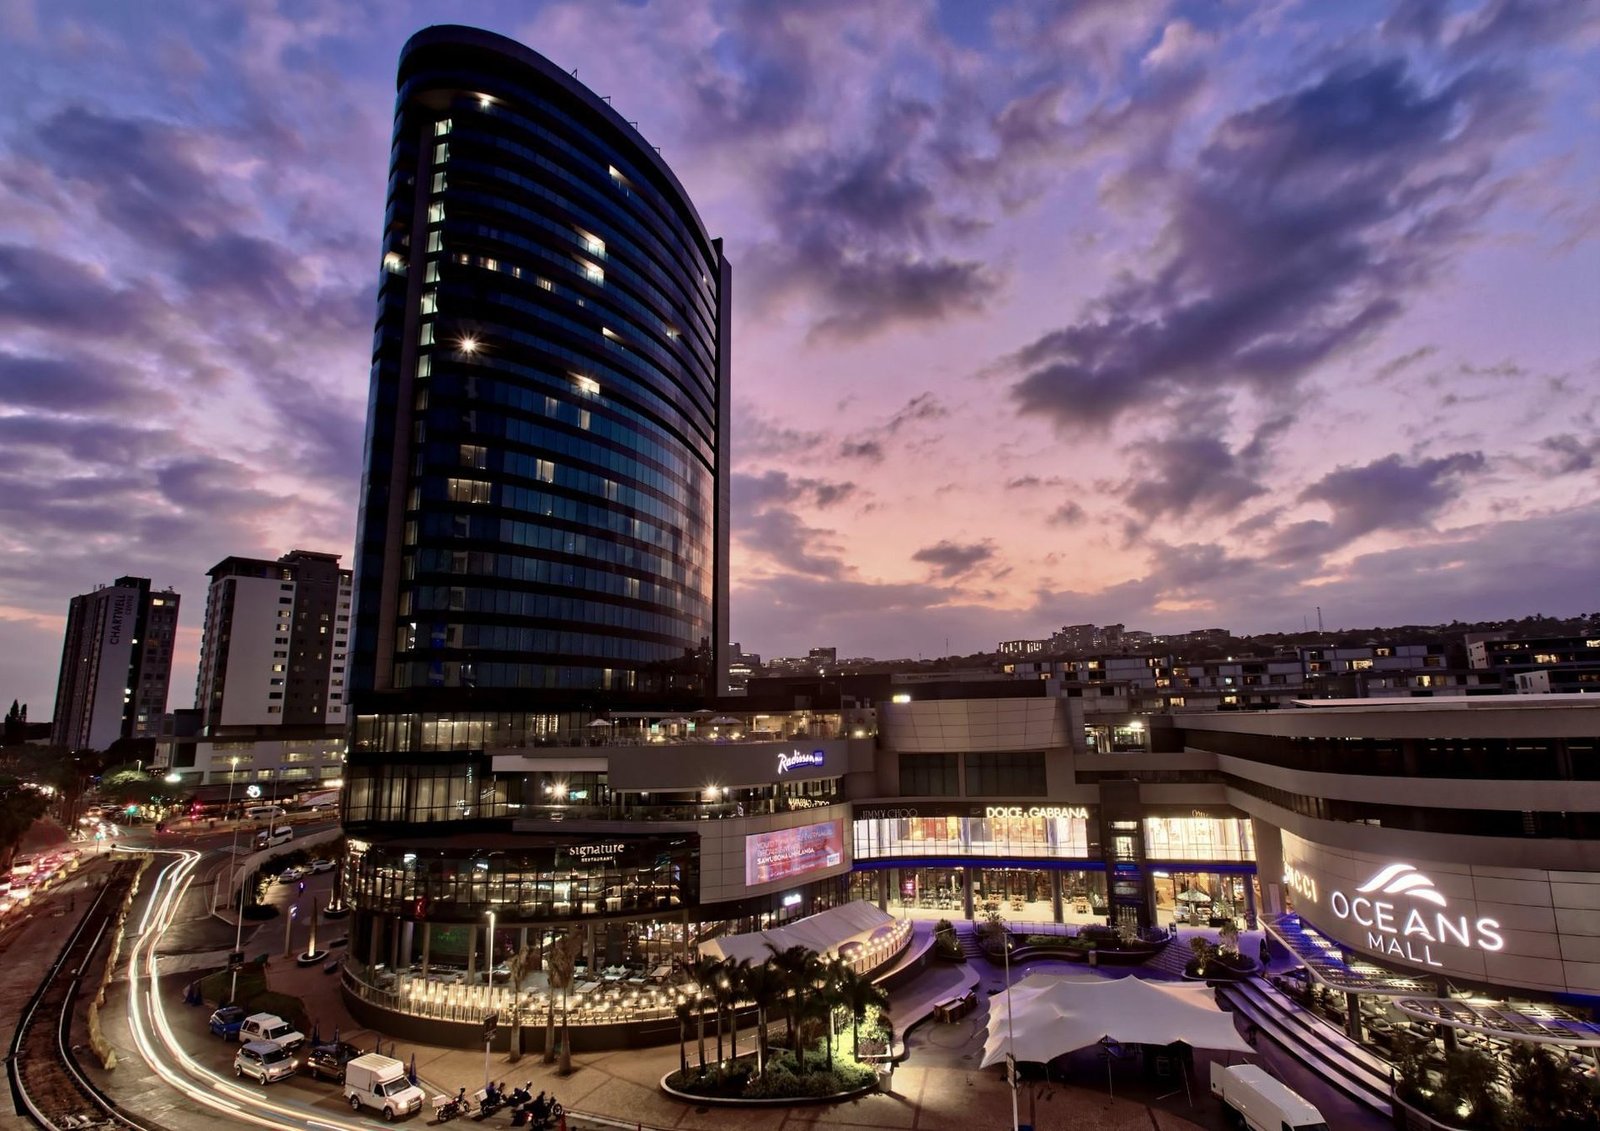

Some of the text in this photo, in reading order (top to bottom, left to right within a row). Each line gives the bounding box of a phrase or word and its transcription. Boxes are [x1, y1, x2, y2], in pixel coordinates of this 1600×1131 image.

[110, 595, 126, 645] CHARTWELL
[777, 749, 815, 775] Radisson
[887, 808, 918, 818] CHOO
[569, 844, 624, 857] signature
[1331, 890, 1504, 951] OCEANS
[1368, 931, 1443, 967] MALL
